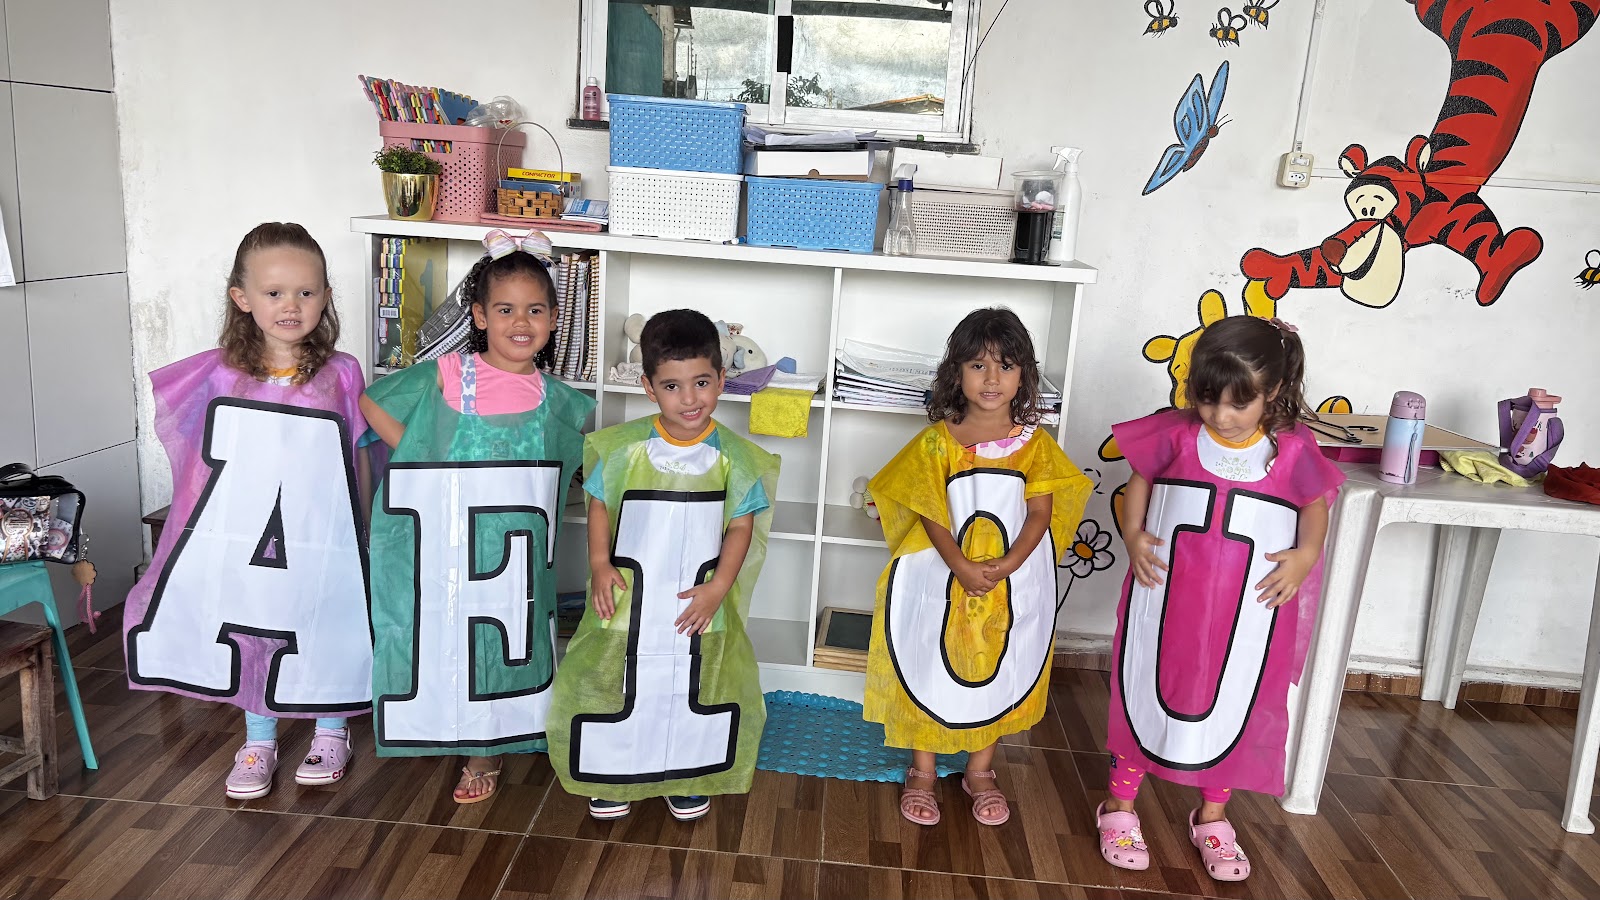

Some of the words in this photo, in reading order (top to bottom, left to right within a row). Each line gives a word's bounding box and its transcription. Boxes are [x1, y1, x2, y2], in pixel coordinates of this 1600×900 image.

[522, 170, 556, 179] COMPACTOR
[128, 398, 375, 712] A
[378, 460, 563, 748] E
[570, 489, 740, 784] I
[885, 468, 1059, 729] O
[1119, 478, 1299, 771] U
